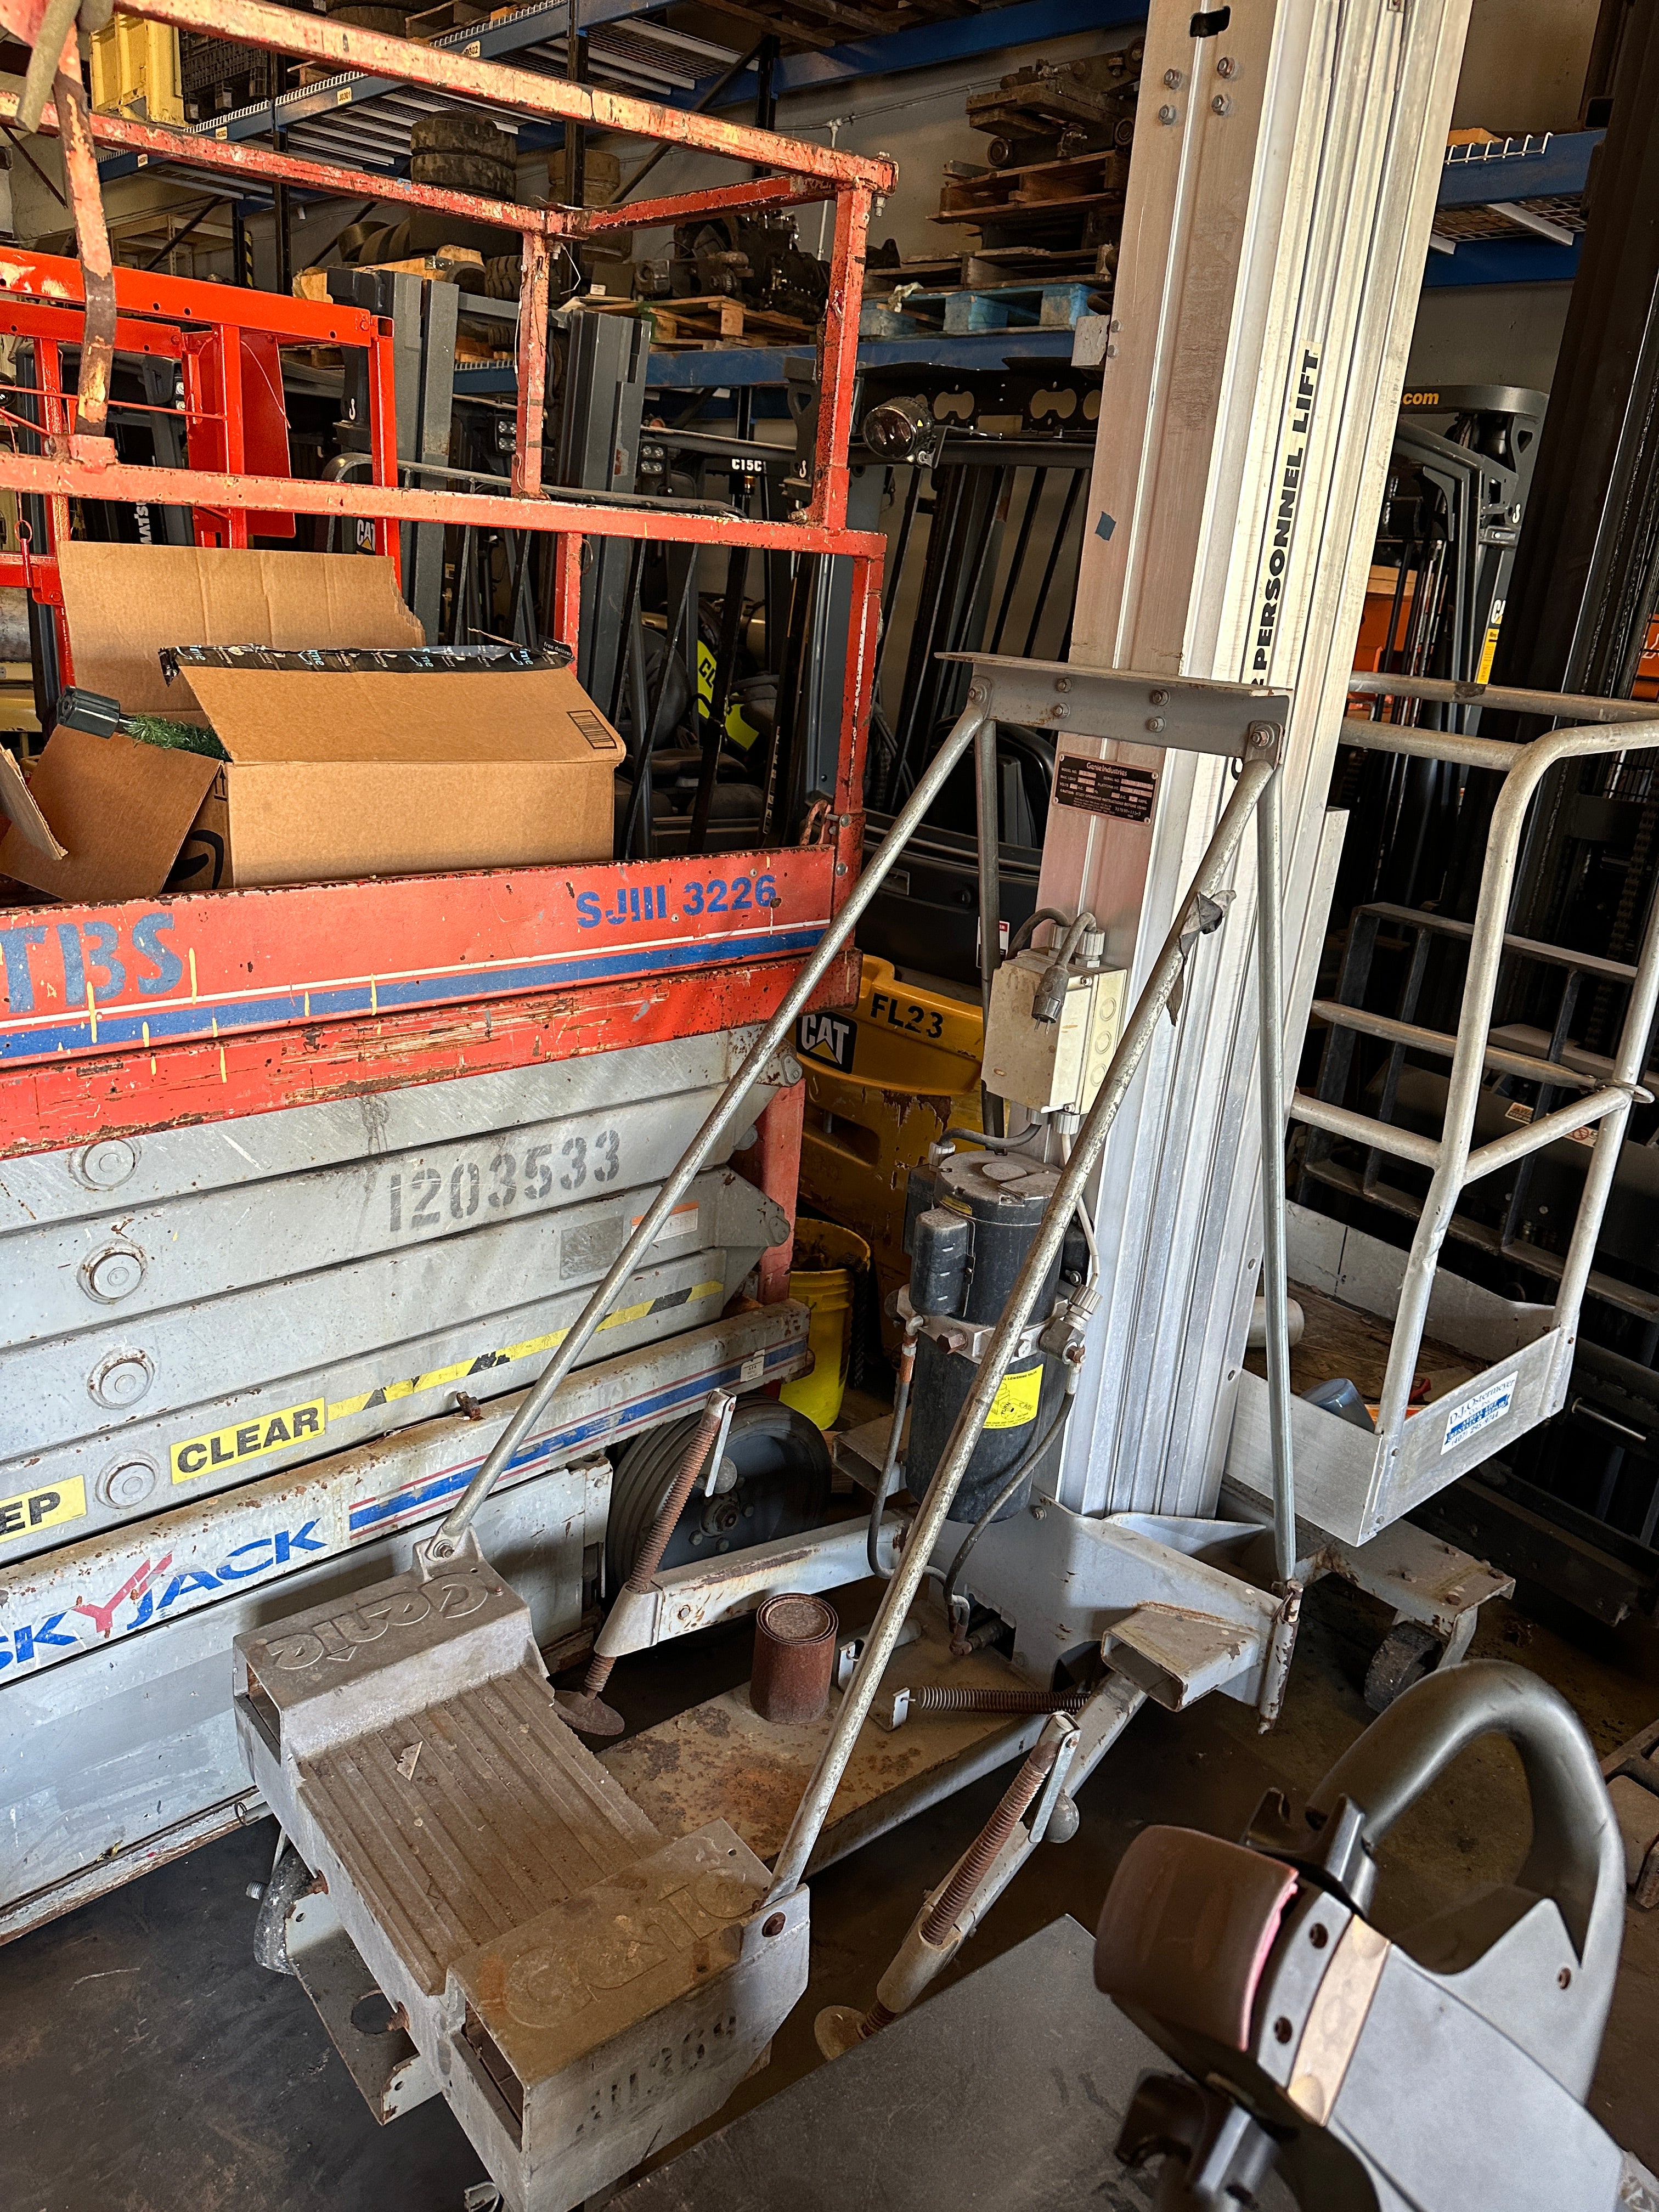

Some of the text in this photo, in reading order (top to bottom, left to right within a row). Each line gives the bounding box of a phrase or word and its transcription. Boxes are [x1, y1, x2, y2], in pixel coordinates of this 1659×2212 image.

[731, 459, 762, 472] C15C
[1253, 349, 1318, 670] PERSONNEL LIFT
[682, 874, 776, 916] 3226
[801, 1014, 850, 1065] CAT
[870, 992, 944, 1039] FL23
[390, 1129, 620, 1232] 1203533
[177, 1407, 320, 1474] CLEAR
